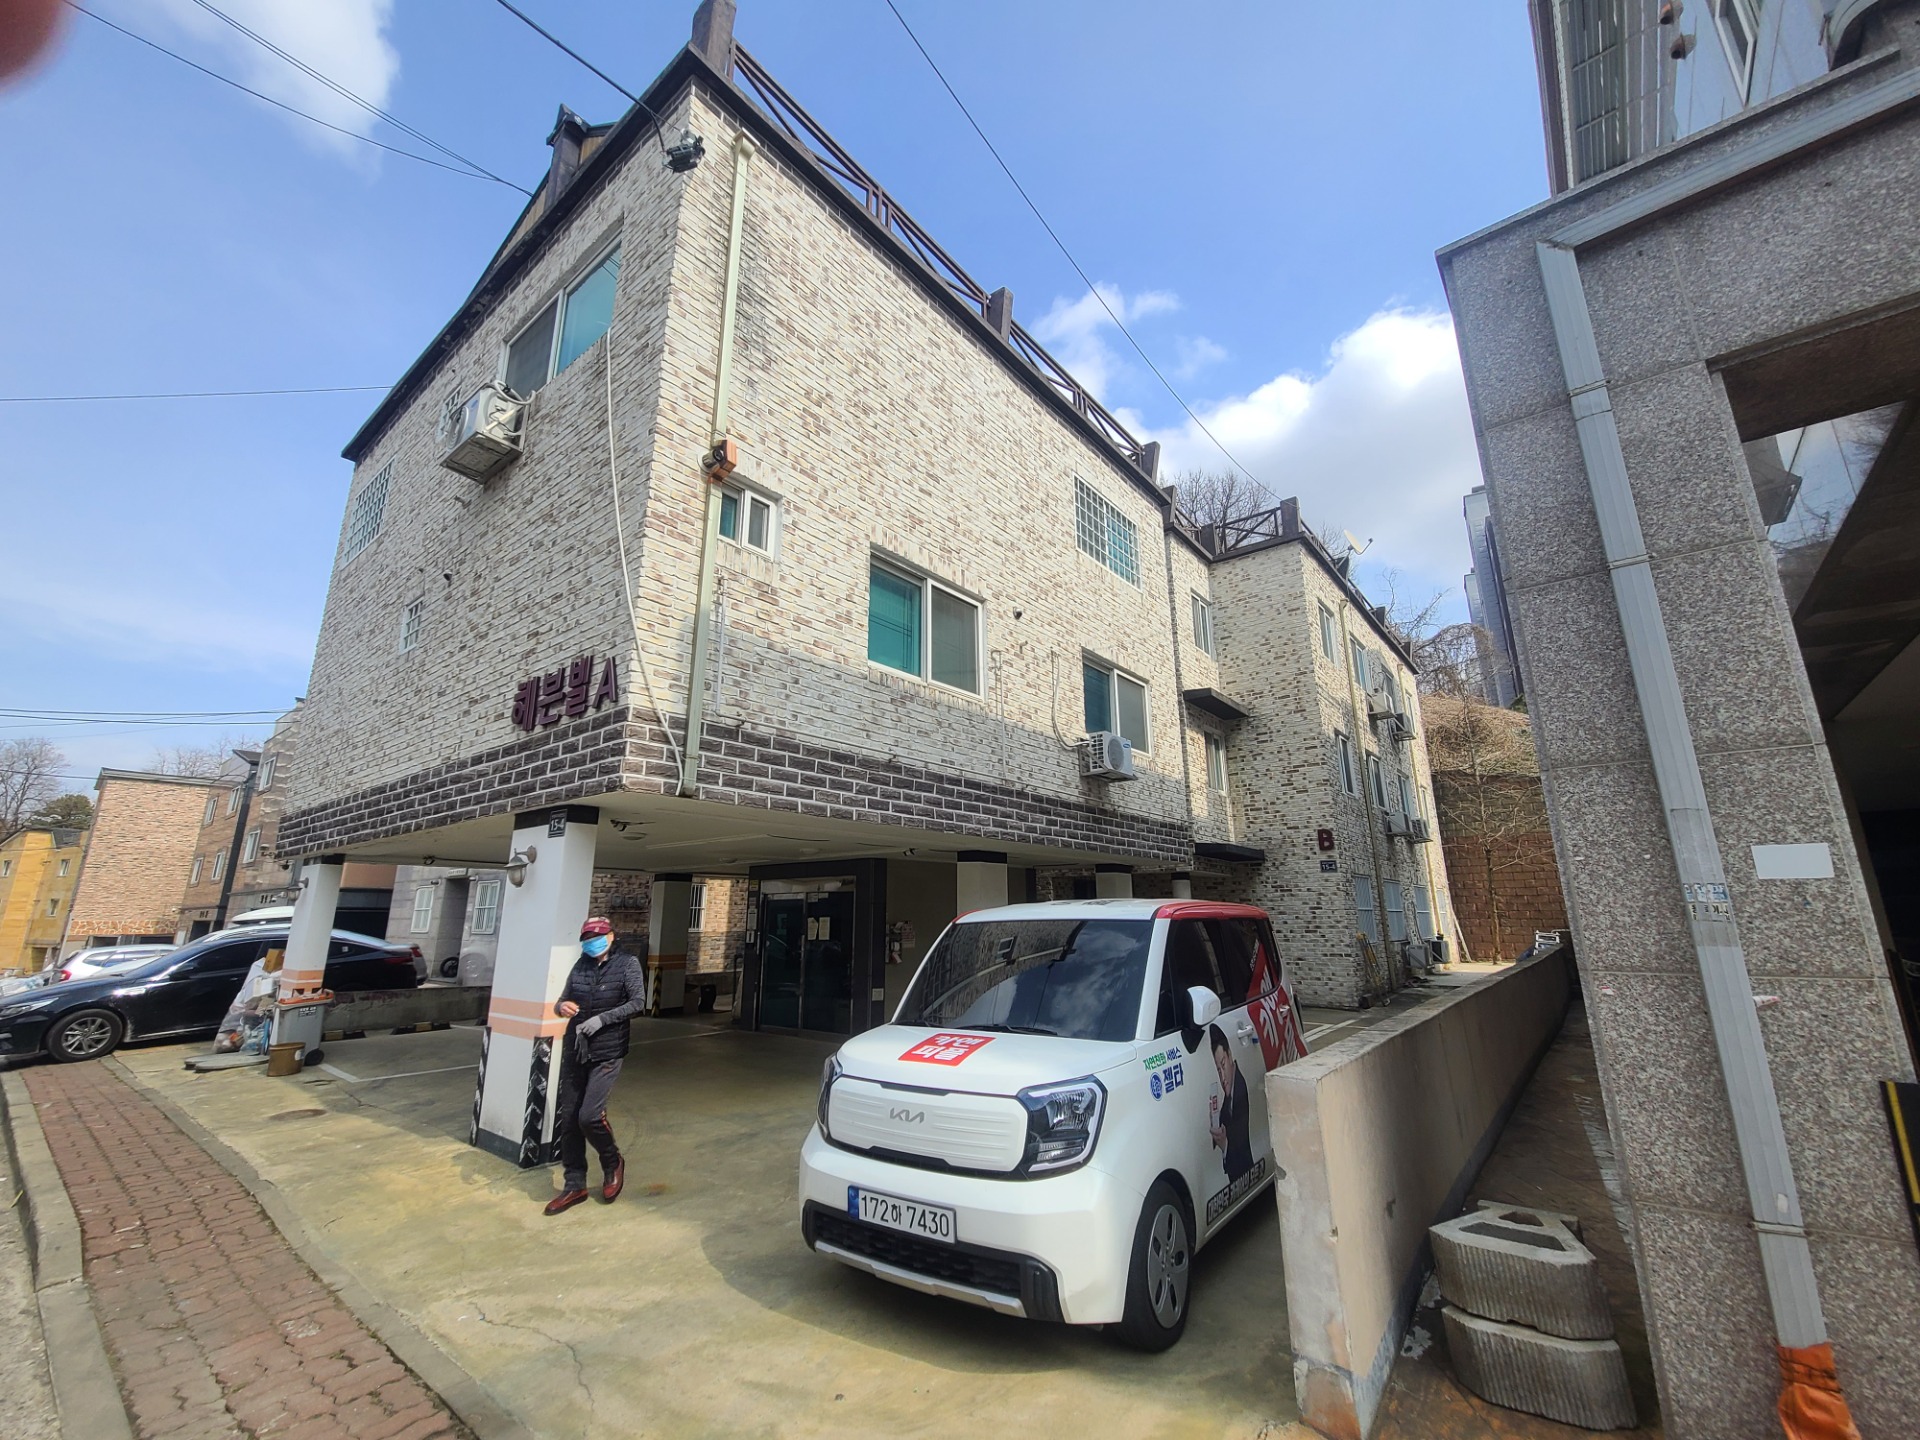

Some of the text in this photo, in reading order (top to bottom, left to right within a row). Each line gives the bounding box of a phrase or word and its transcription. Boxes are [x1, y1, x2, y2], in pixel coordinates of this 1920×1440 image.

[1317, 828, 1335, 851] B
[911, 1045, 969, 1061] 피플
[1166, 1046, 1183, 1062] 서비스
[1162, 1062, 1184, 1094] 젤타
[889, 1107, 925, 1124] KIA
[861, 1195, 949, 1237] 172하 7430
